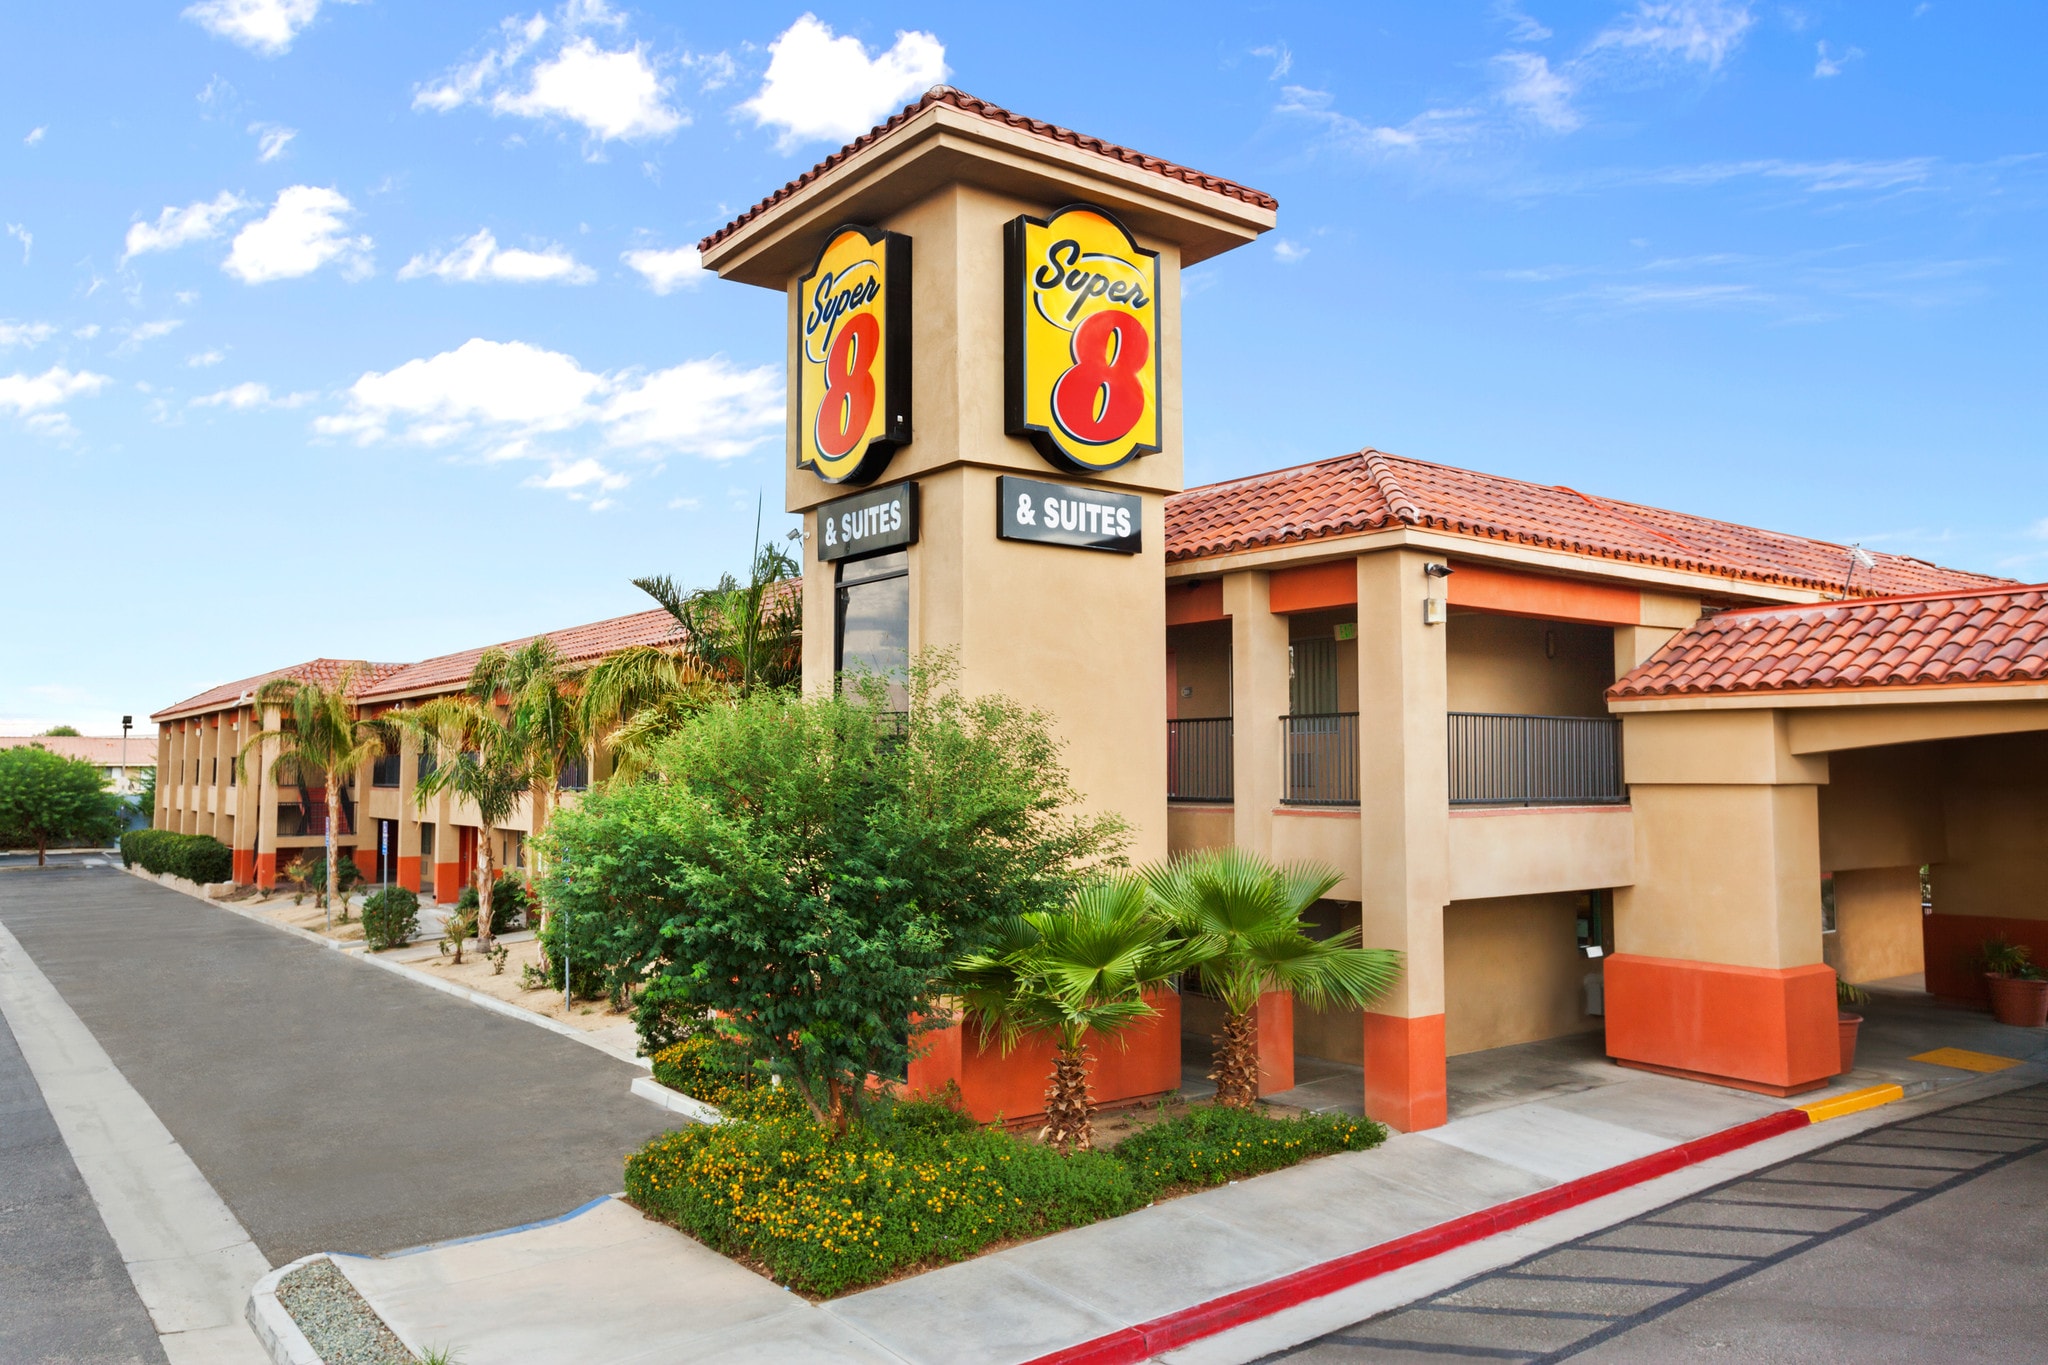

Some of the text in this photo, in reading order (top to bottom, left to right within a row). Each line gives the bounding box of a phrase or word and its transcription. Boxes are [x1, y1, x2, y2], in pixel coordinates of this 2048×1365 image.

[806, 272, 881, 352] Super
[1034, 239, 1150, 322] Super
[814, 312, 880, 462] 8
[1050, 310, 1150, 446] 8
[825, 500, 902, 547] & SUITES
[1016, 493, 1131, 537] & SUITES
